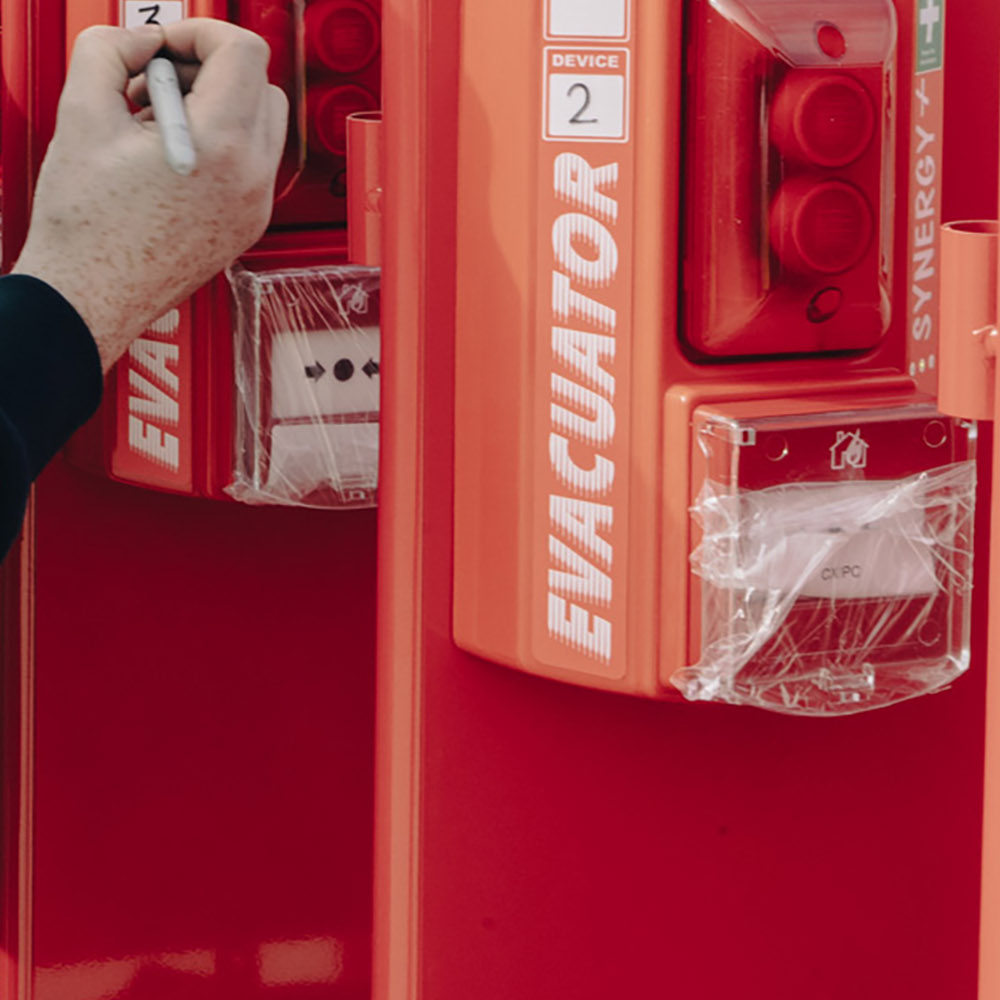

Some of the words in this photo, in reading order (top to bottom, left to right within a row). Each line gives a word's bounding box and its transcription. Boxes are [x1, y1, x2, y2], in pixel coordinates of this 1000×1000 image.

[552, 54, 619, 68] DEVICE
[567, 83, 598, 123] 2
[912, 125, 935, 341] SYNERGY
[547, 152, 619, 665] EVACUATOR
